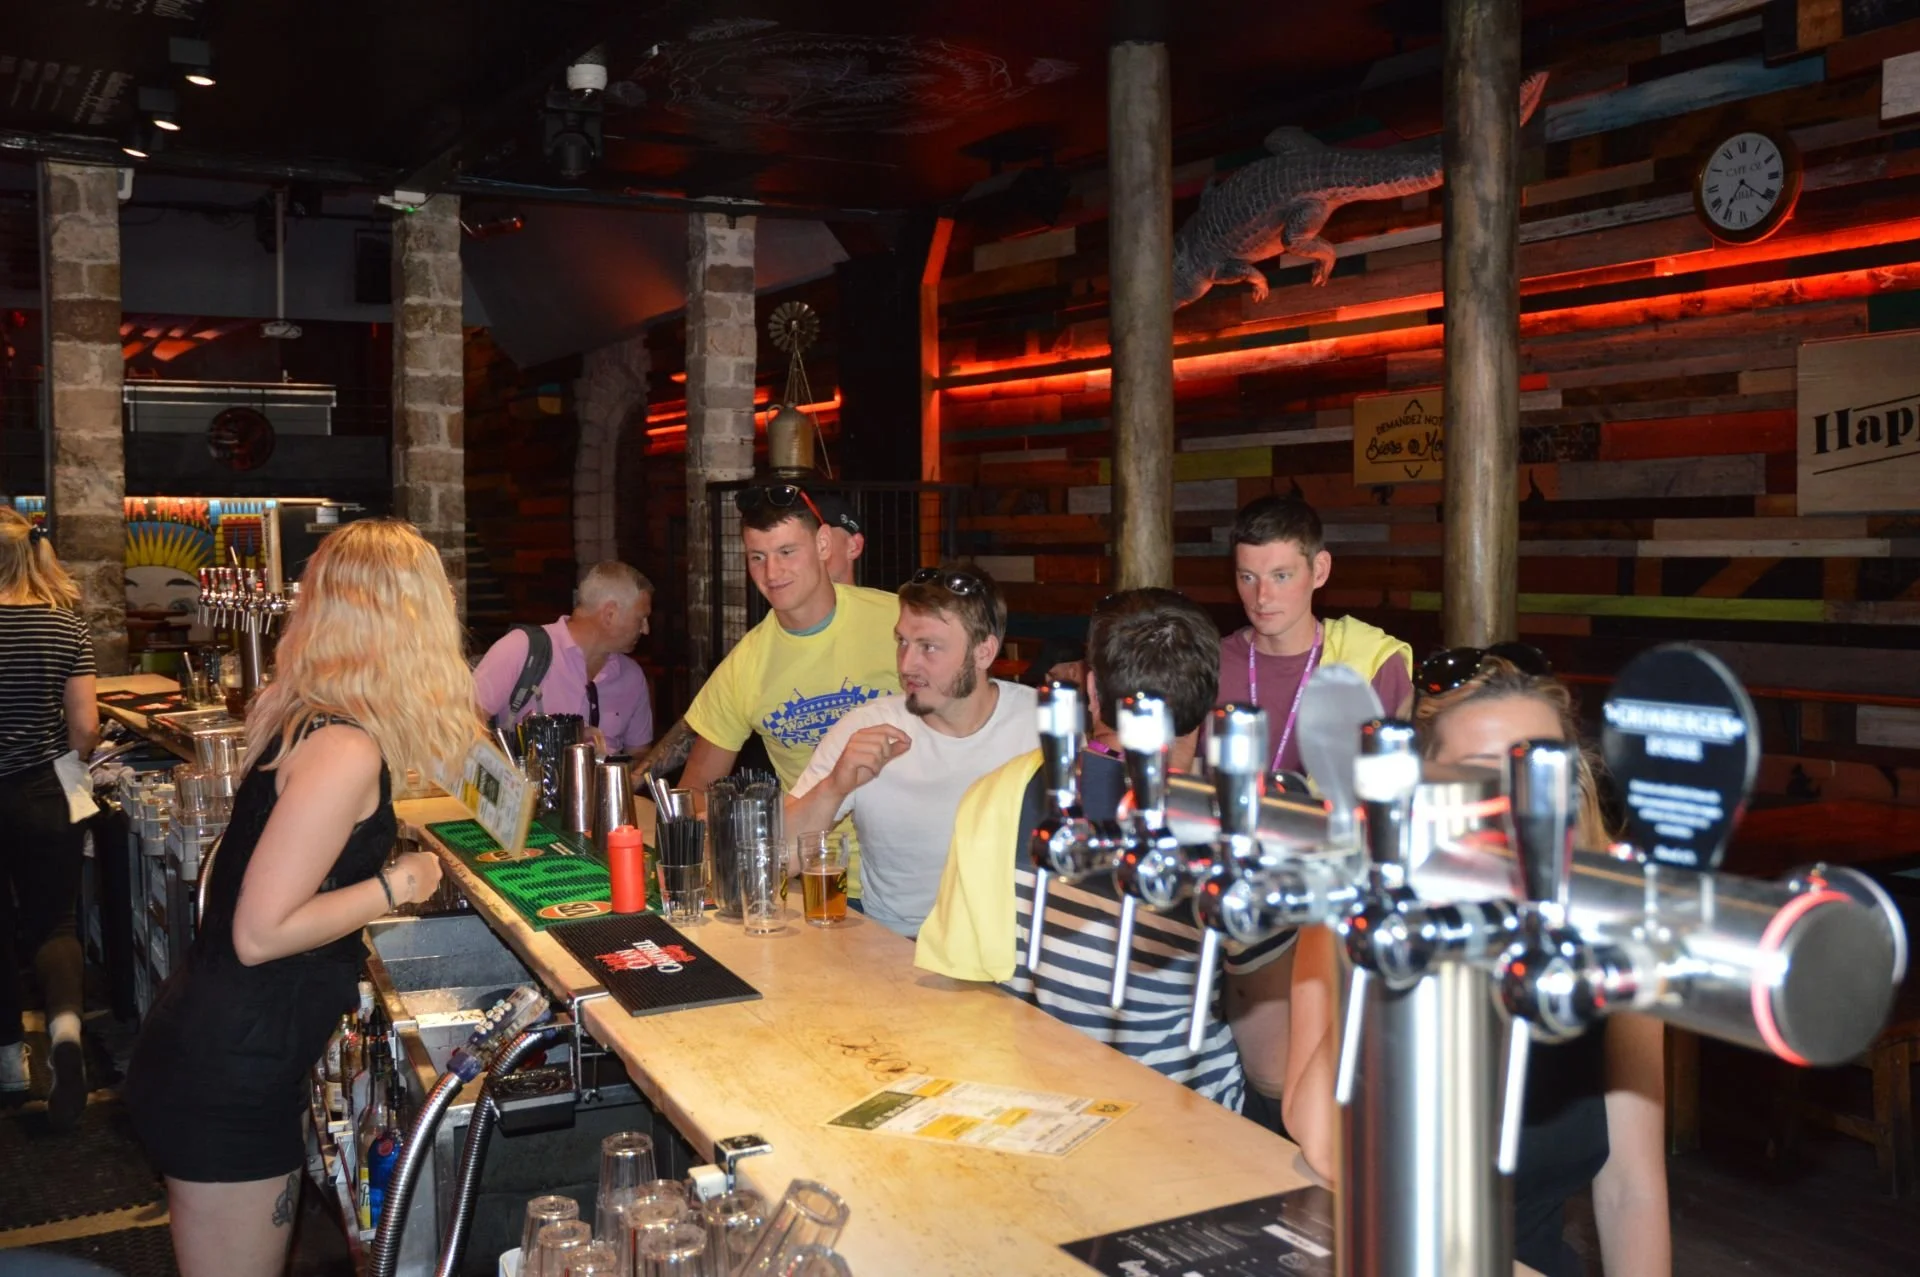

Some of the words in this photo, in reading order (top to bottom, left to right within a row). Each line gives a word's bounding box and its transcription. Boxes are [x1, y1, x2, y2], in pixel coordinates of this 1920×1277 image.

[1376, 414, 1422, 435] DEMANDEZ
[1813, 405, 1920, 455] Hap
[783, 711, 828, 734] Wacky
